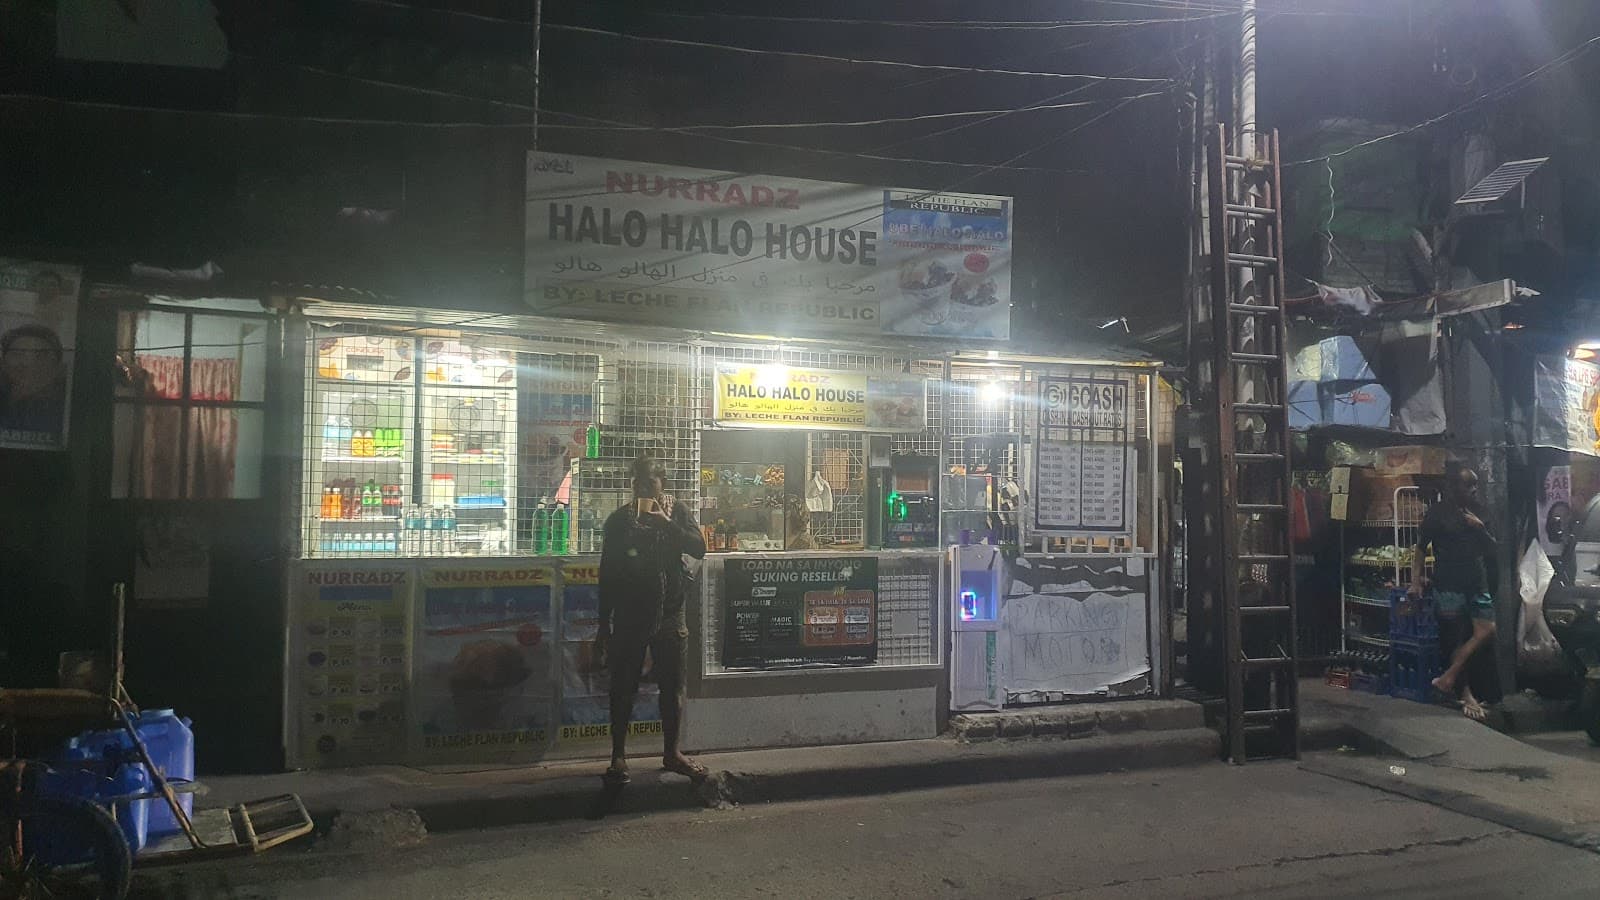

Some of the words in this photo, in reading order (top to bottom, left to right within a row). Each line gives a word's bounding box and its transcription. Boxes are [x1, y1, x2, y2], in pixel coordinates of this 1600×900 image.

[605, 170, 800, 210] NURRADZ
[910, 203, 984, 214] REPUBLIC
[549, 202, 648, 248] HALO
[660, 212, 753, 257] HALO
[765, 222, 877, 267] HOUSE
[551, 255, 603, 274] هالو
[594, 288, 679, 309] LECHE
[727, 383, 767, 399] HALO
[772, 386, 811, 401] HALO
[815, 388, 864, 404] HOUSE
[745, 412, 777, 420] LECHE
[782, 414, 810, 422] FLAN
[813, 415, 864, 424] REPUBLIC
[742, 560, 773, 570] LOAD
[776, 560, 794, 569] NA
[797, 560, 812, 569] SA
[308, 571, 406, 585] NURRADZ
[431, 569, 544, 582] NURRADZ
[752, 571, 799, 583] SUKING
[563, 727, 578, 738] BY:
[580, 725, 608, 738] LECHE
[634, 722, 666, 735] REPUB
